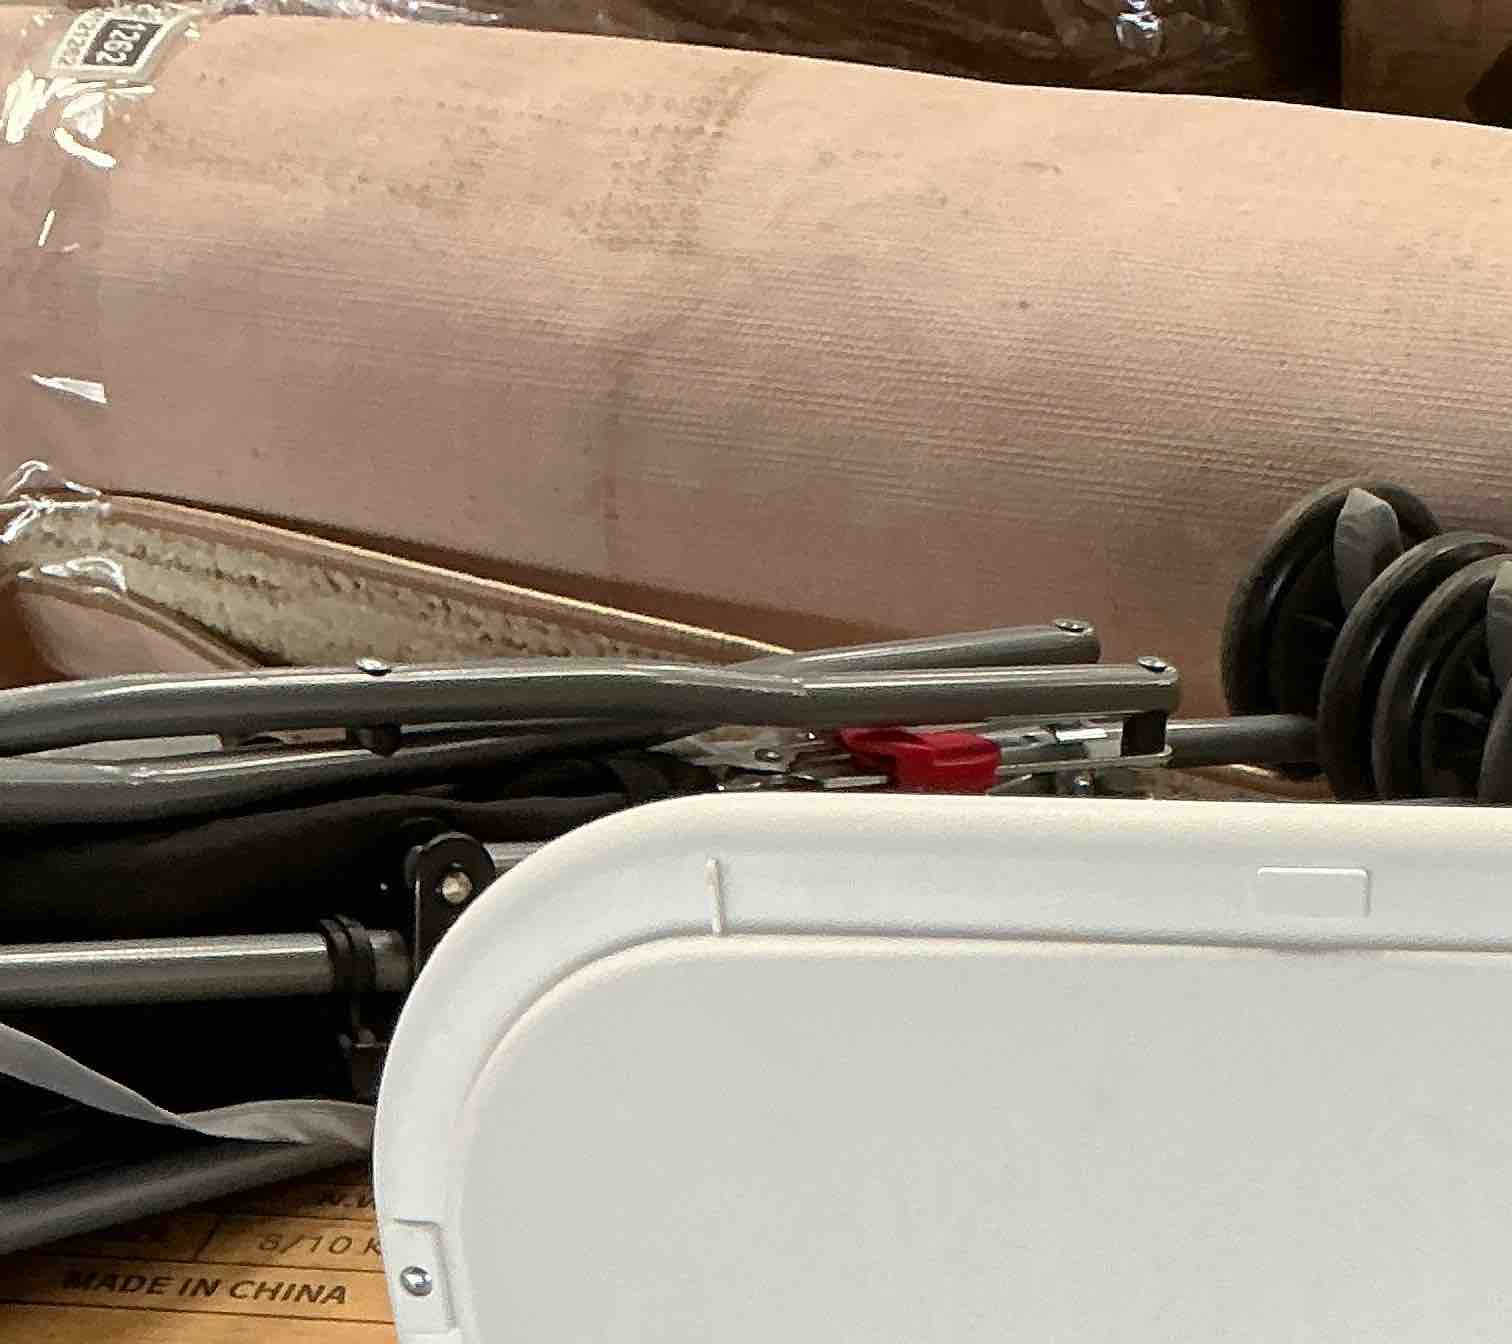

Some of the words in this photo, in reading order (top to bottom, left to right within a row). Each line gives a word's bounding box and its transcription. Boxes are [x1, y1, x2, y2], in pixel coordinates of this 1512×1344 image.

[95, 22, 147, 65] 1262
[62, 1269, 174, 1296] MADE
[179, 1276, 222, 1298] IN
[230, 1279, 348, 1305] CHINA
